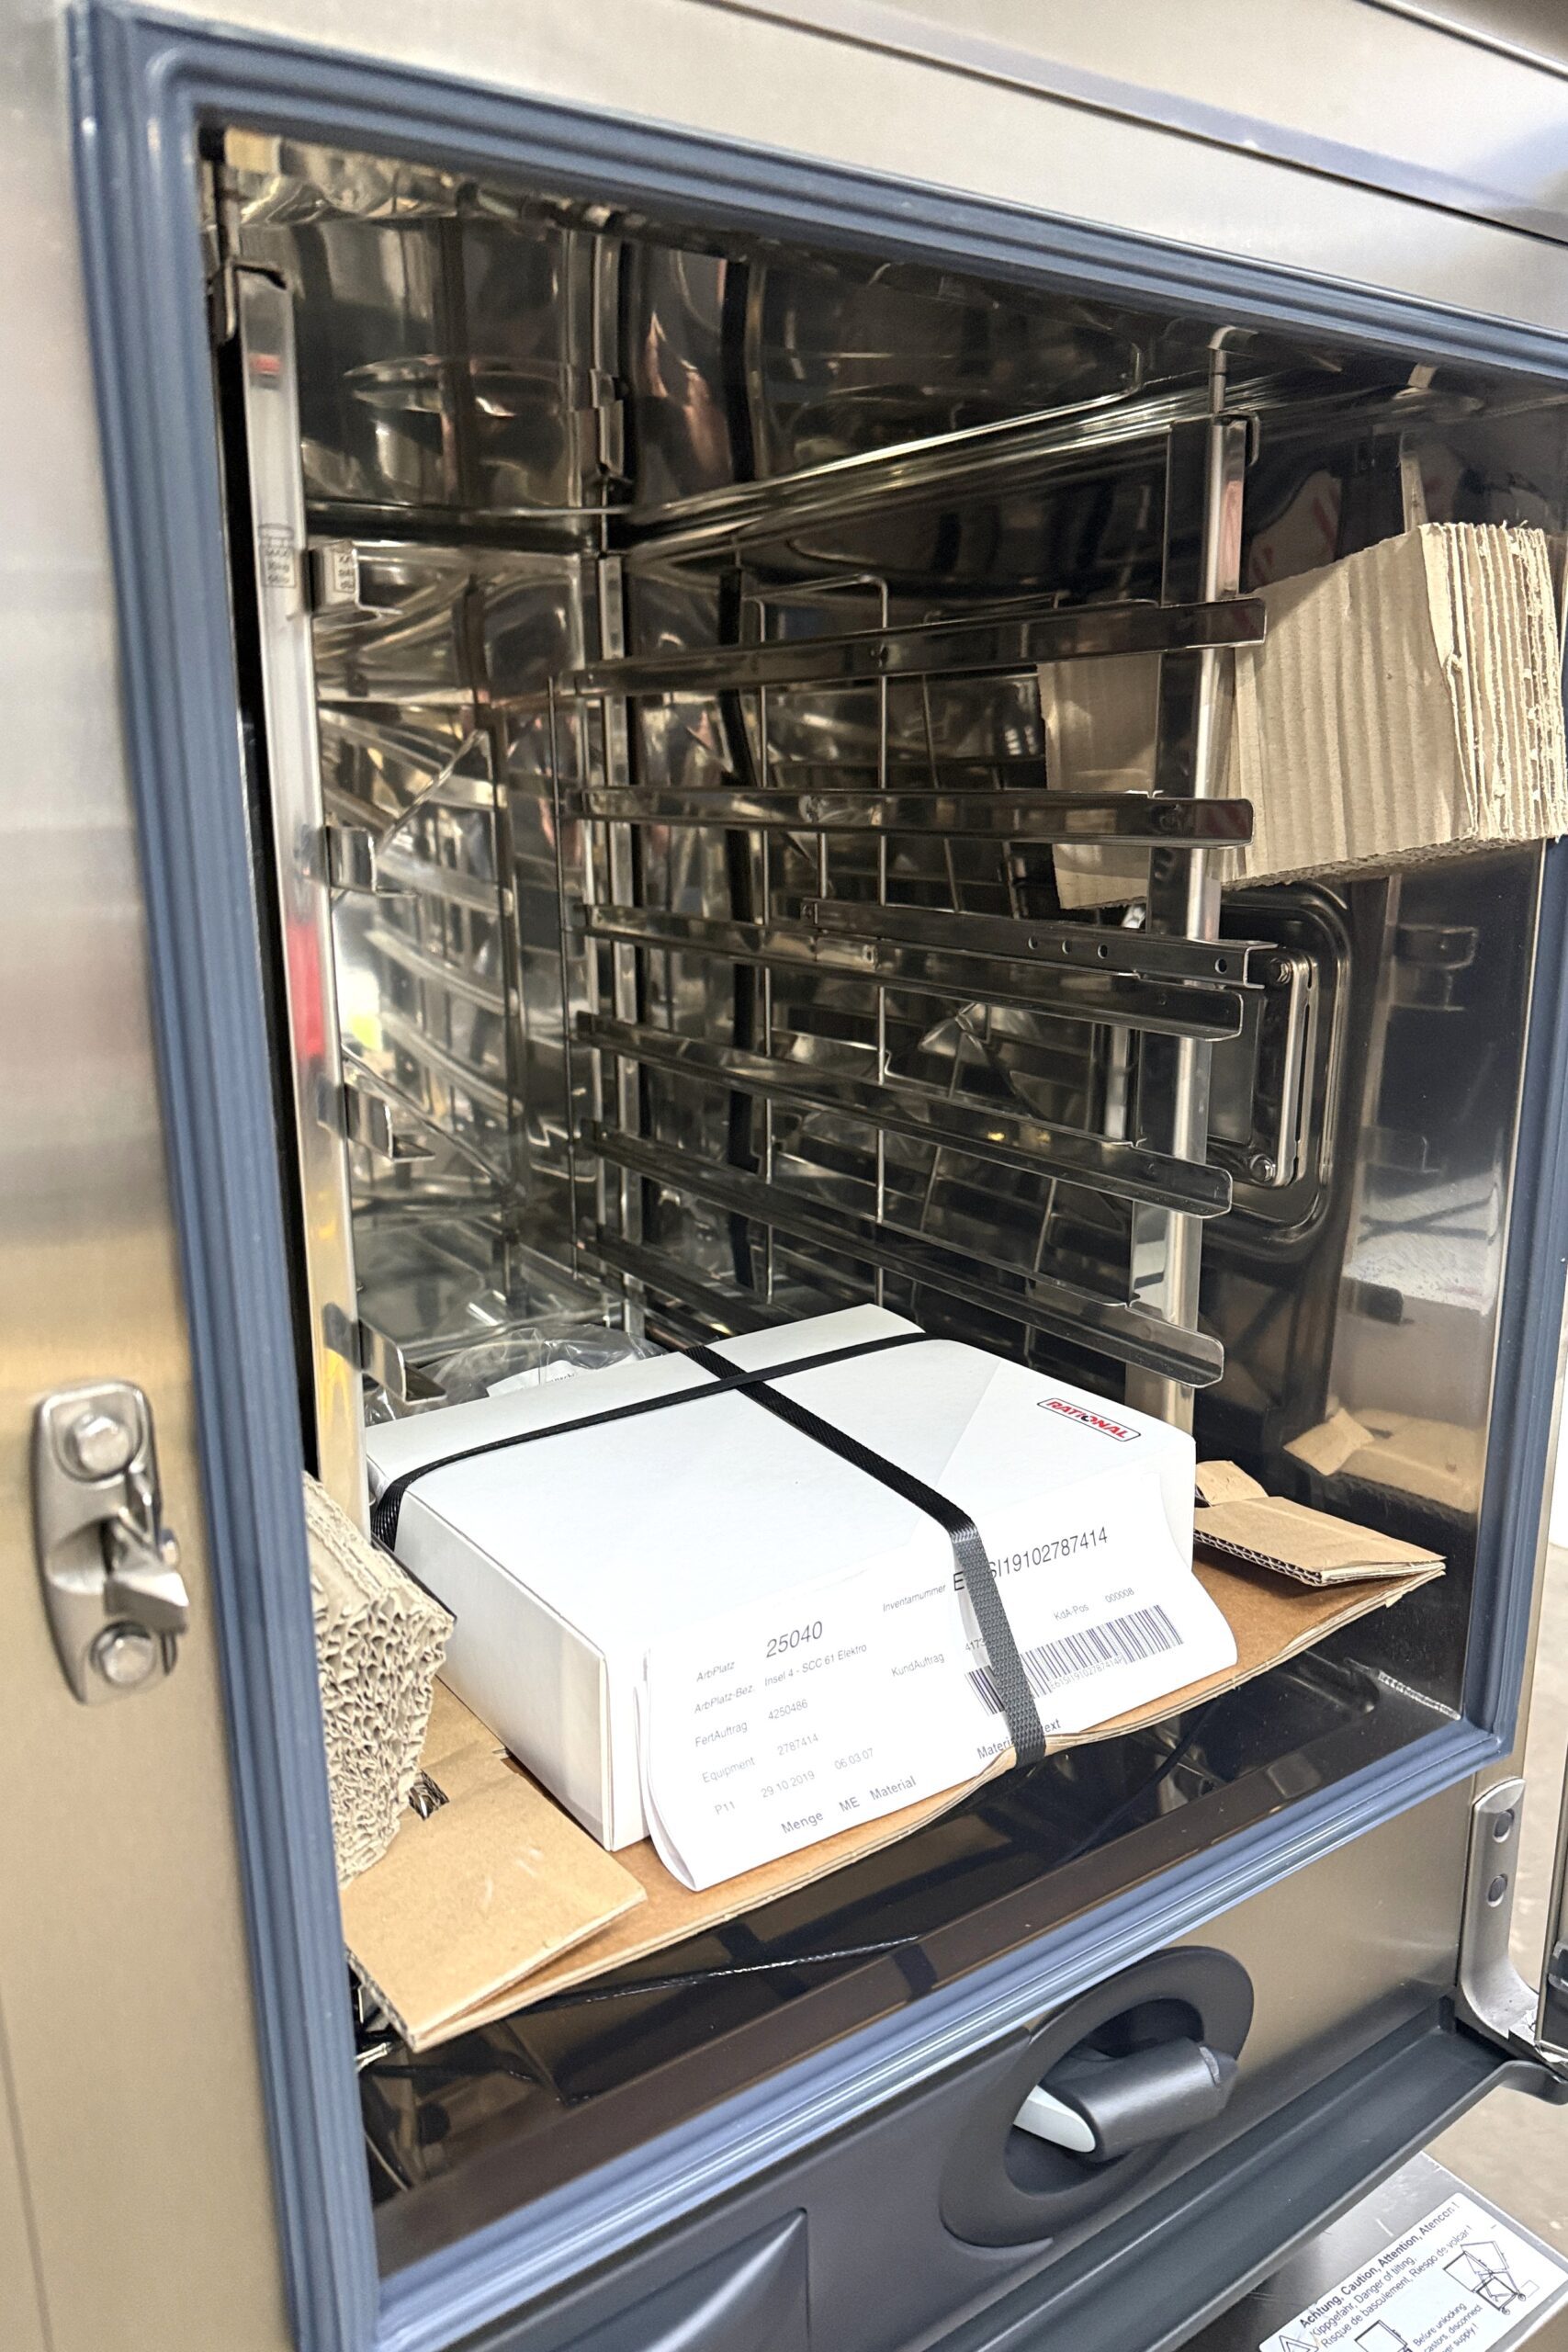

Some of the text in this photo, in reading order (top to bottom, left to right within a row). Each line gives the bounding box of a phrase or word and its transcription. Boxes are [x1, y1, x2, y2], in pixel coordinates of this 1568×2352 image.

[1046, 1400, 1129, 1439] RATIONAL
[953, 1526, 1108, 1591] ESI19102787414
[1105, 1587, 1135, 1603] 000008
[696, 1620, 823, 1682] ArbPlatz 25040
[764, 1670, 786, 1686] Insel
[788, 1668, 795, 1678] 4
[802, 1657, 823, 1673] SCC
[824, 1653, 835, 1665] 61
[837, 1644, 868, 1660] Elektro
[891, 1652, 945, 1678] KundAuftrag
[694, 1698, 809, 1747] FertAuftrag 4250486
[702, 1733, 820, 1783] Equipment 2787414
[781, 1774, 917, 1835] Menge ME Material
[1299, 2295, 1345, 2329] Achtung,
[1340, 2266, 1382, 2296] Caution,
[1378, 2234, 1424, 2268] Attention,
[1320, 2324, 1352, 2349] Risque
[1350, 2314, 1364, 2326] de
[1359, 2276, 1415, 2317] basculement,
[1408, 2254, 1438, 2278] Riesgo
[1353, 2278, 1385, 2304] Danger
[1383, 2270, 1393, 2282] of
